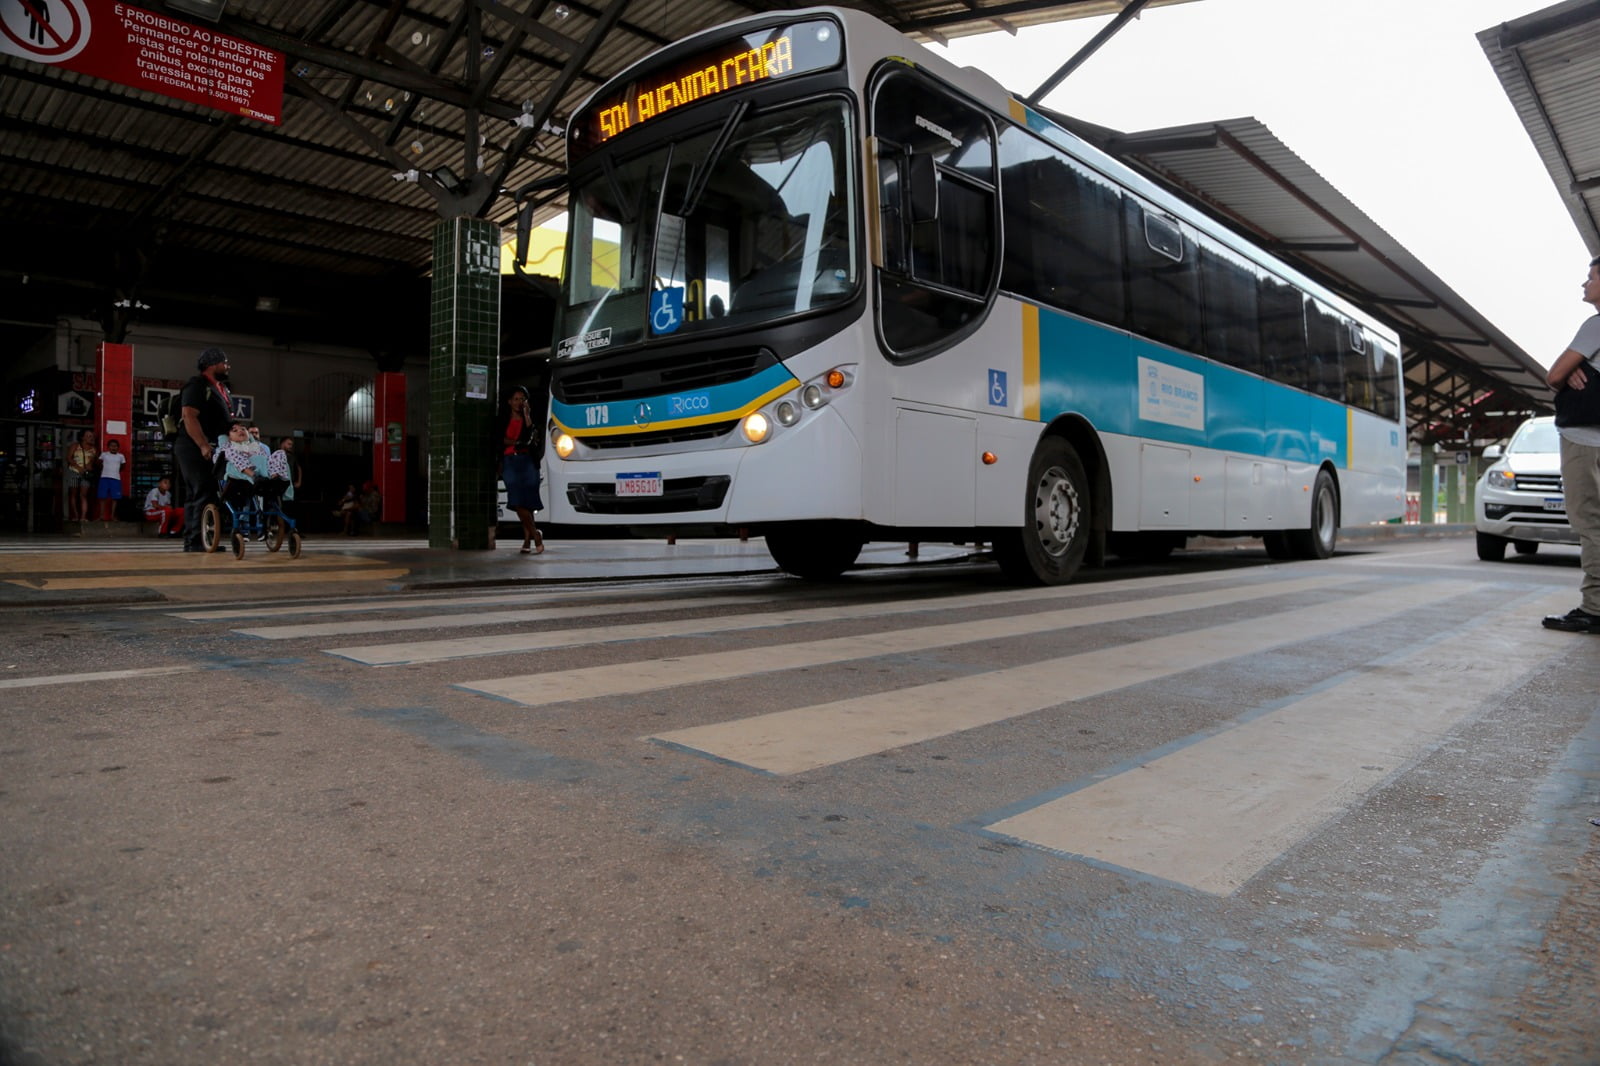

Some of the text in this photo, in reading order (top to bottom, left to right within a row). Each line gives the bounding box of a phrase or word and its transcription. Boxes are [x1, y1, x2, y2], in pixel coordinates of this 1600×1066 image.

[114, 3, 277, 63] É PROIBIDO AO PEDESTRE:
[127, 33, 264, 80] pistas de rolamento dos
[140, 47, 252, 87] ônibus, exceto para
[201, 45, 215, 55] ou
[218, 50, 251, 65] andar
[253, 60, 272, 72] nas
[136, 57, 191, 81] travessia
[194, 75, 214, 87] nas
[141, 70, 158, 81] (LEI
[159, 75, 196, 91] FEDERAL
[585, 405, 609, 426] 1879
